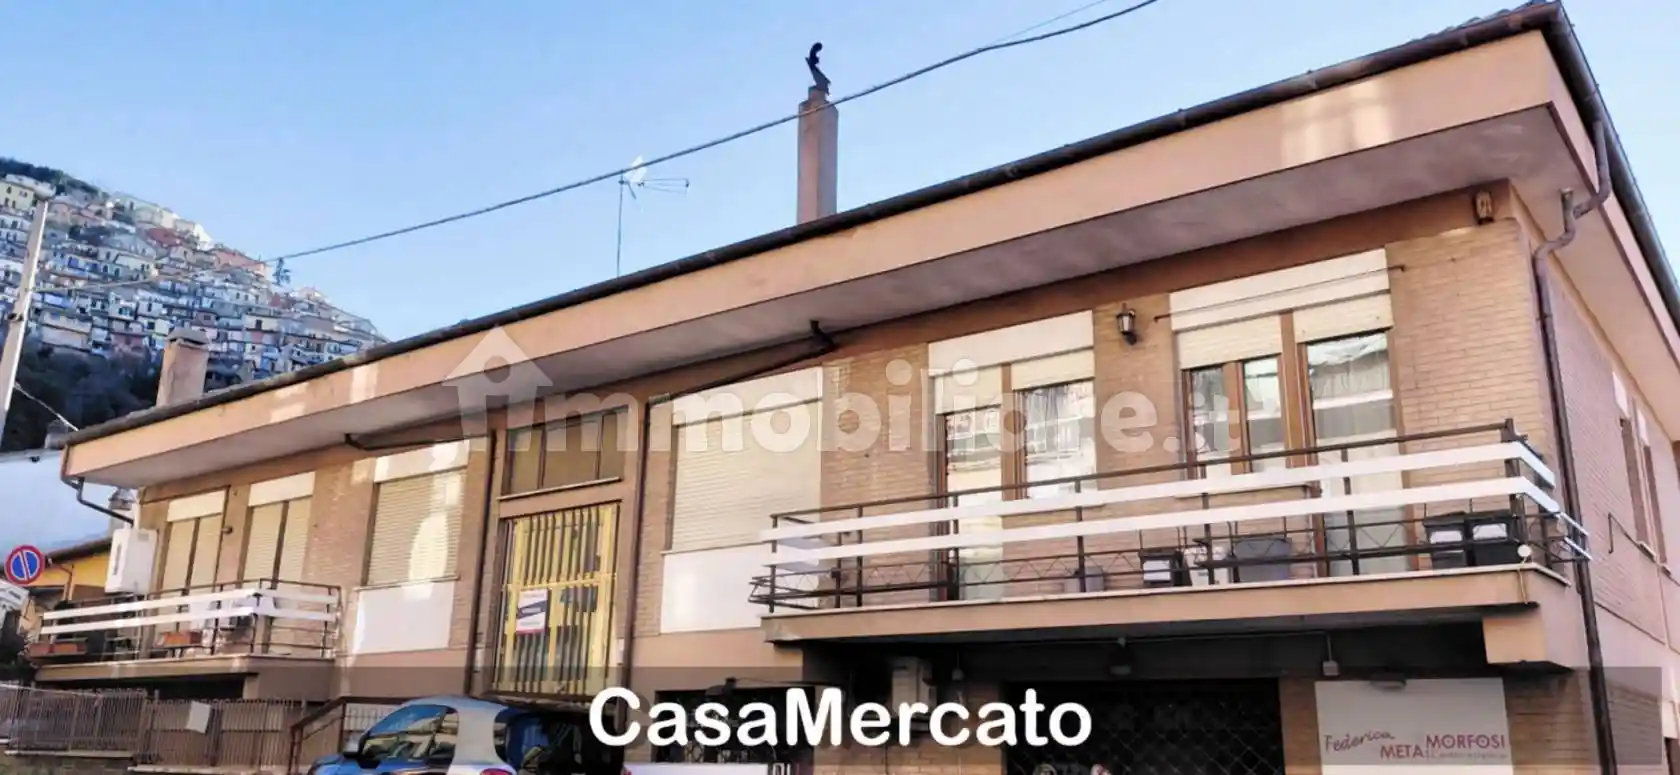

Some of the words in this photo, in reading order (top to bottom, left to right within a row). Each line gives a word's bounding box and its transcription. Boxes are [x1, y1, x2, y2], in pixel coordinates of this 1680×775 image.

[1323, 730, 1396, 755] Federica
[1380, 744, 1424, 760] META
[1426, 734, 1506, 750] MORFOSI
